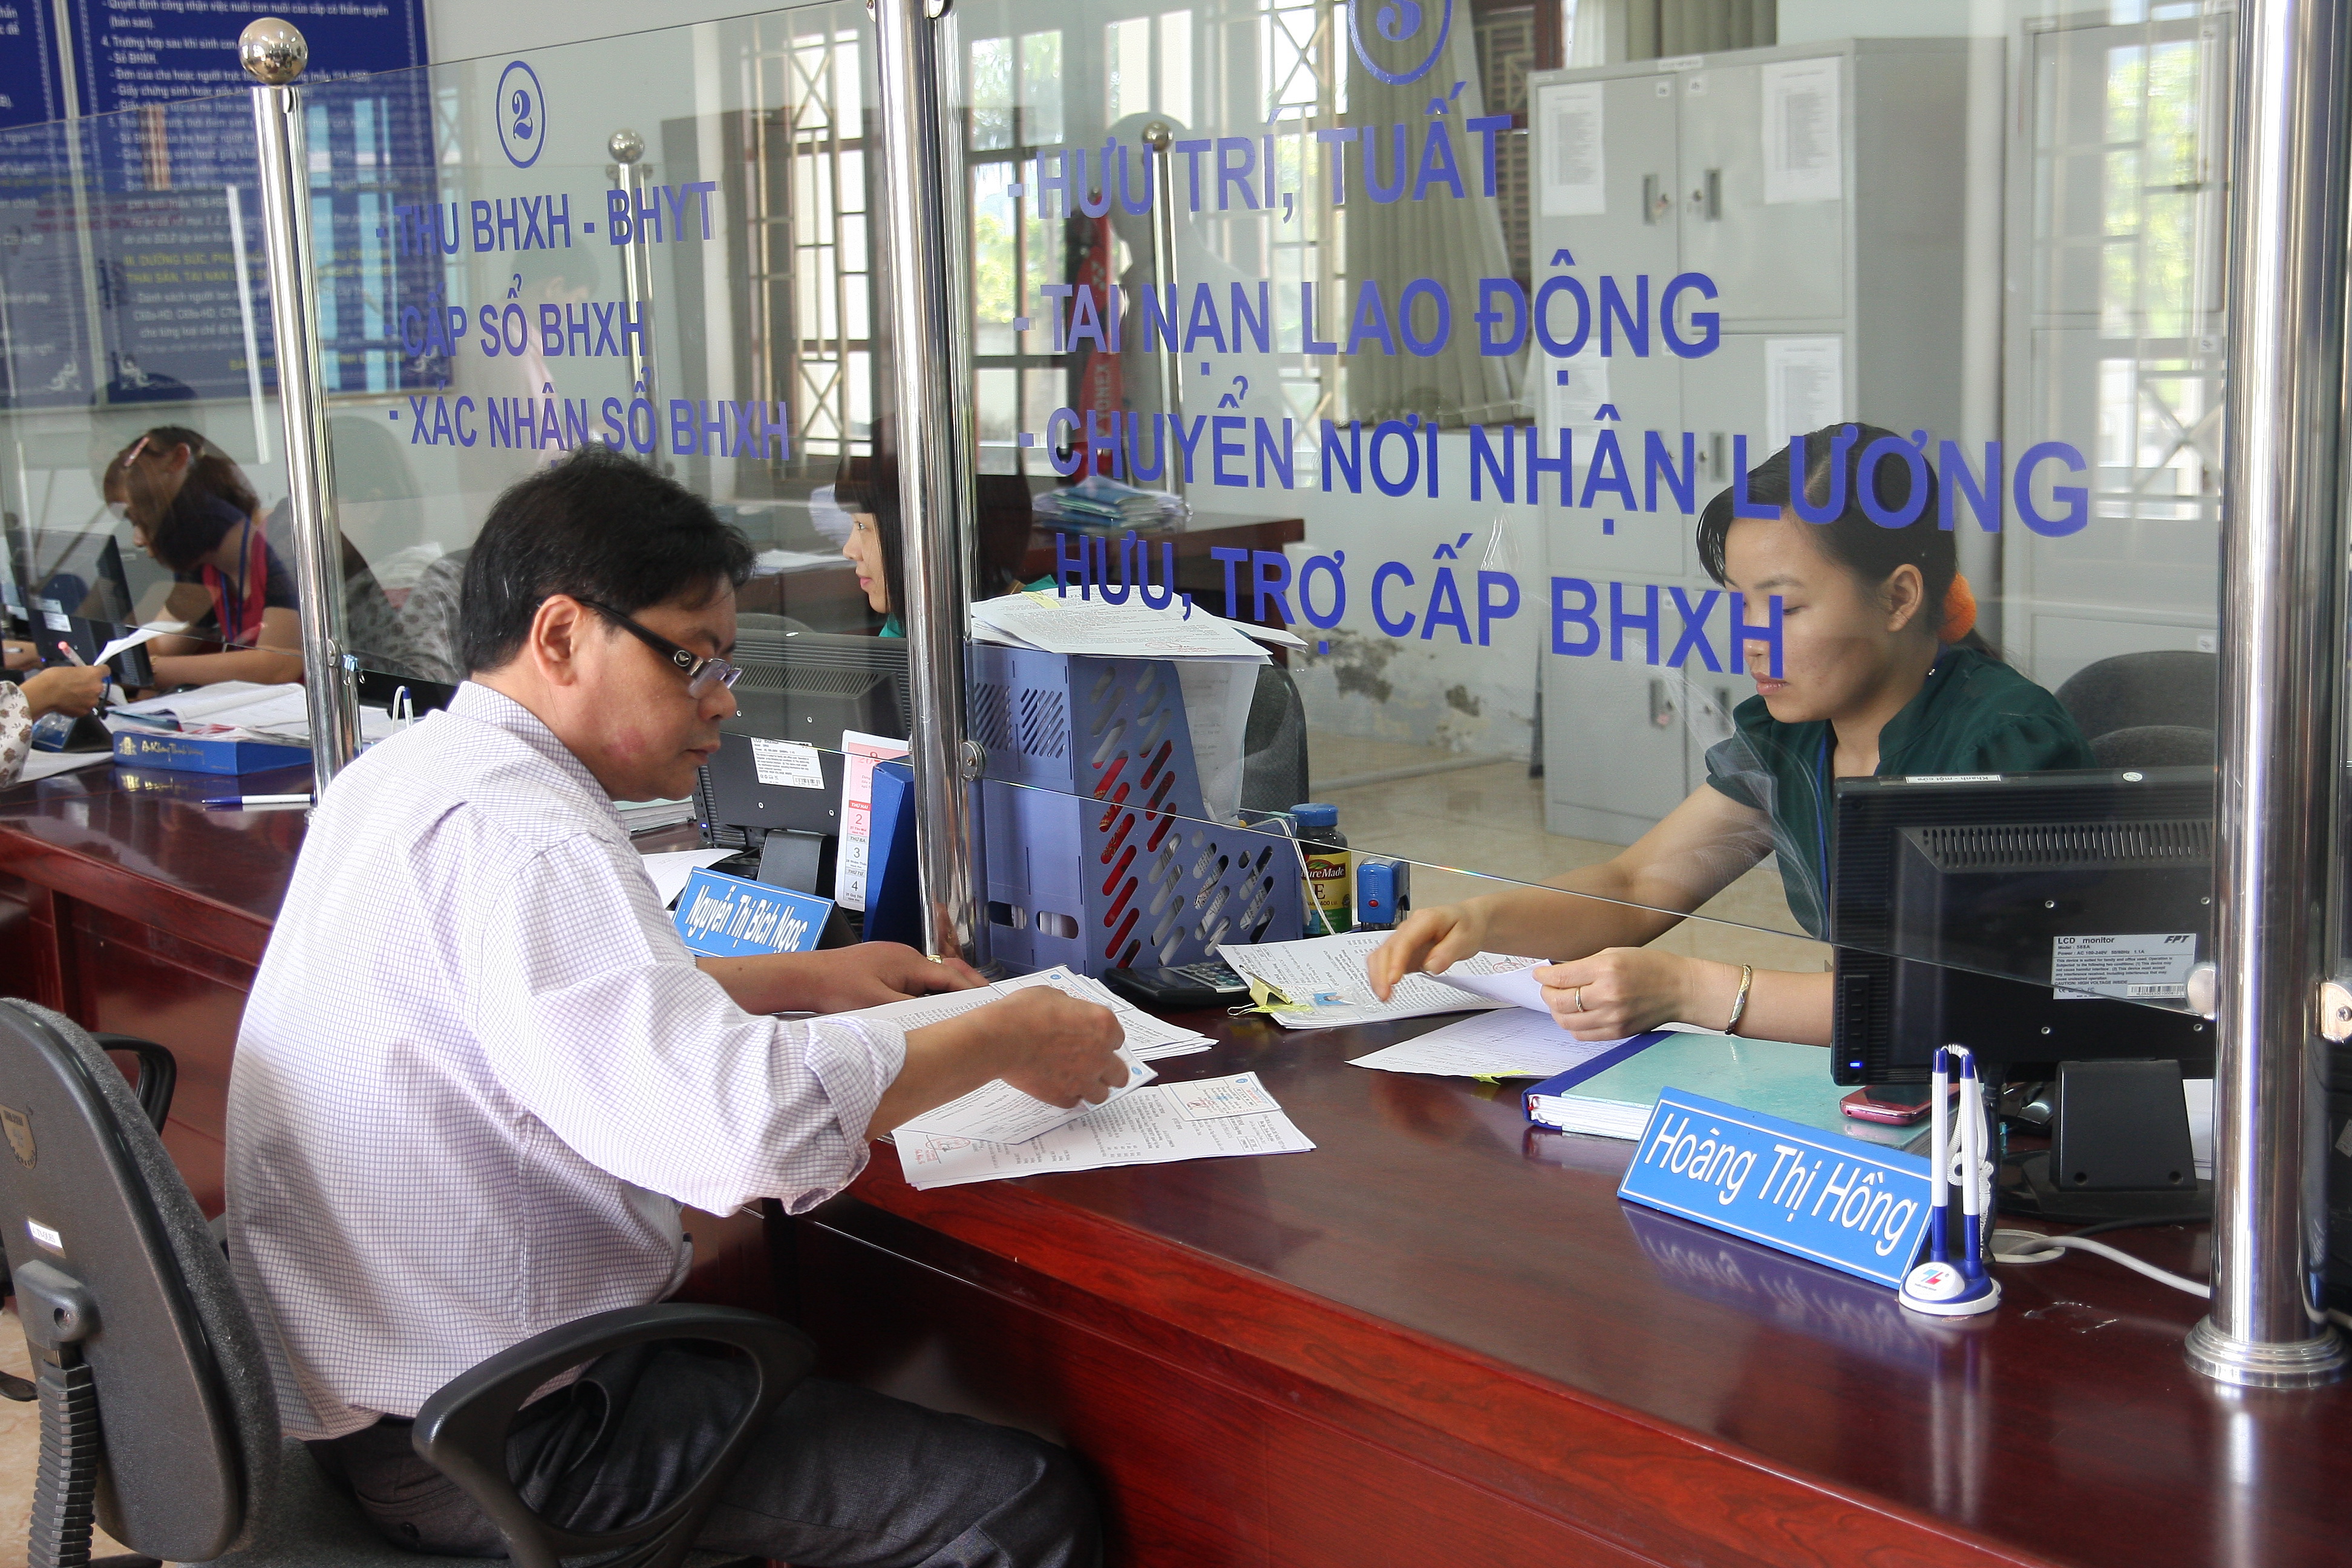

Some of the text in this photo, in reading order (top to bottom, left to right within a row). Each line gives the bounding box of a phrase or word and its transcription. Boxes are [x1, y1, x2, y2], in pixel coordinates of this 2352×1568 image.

[512, 90, 532, 140] 2
[1037, 137, 1154, 219] HƯU
[1176, 108, 1293, 224] TRÍ,
[1317, 81, 1512, 204] TUẤT
[394, 203, 460, 255] THU
[472, 194, 570, 252] BHXH
[607, 181, 716, 246] BHYT
[402, 274, 645, 357] CẤP SỔ BHXH
[1040, 249, 1720, 386] TAI NẠN LAO ĐỘNG
[409, 380, 477, 447] XÁC
[602, 366, 656, 454] SỔ
[670, 399, 790, 460] BHXH
[1047, 375, 2089, 538] CHUYỂN NƠI NHẬN LƯƠNG
[1056, 530, 1192, 620] HƯU,
[1211, 546, 1347, 655] TRỢ
[1371, 533, 1520, 647] CẤP
[1551, 577, 1784, 679] BHXH
[854, 847, 860, 858] 3
[855, 814, 862, 825] 2
[685, 884, 737, 941] Nguyễn
[727, 894, 757, 949] Thị
[743, 898, 782, 946] Bích
[851, 880, 858, 891] 4
[1313, 884, 1325, 900] E
[1644, 1112, 1918, 1256] Hoàng Thị Hồng
